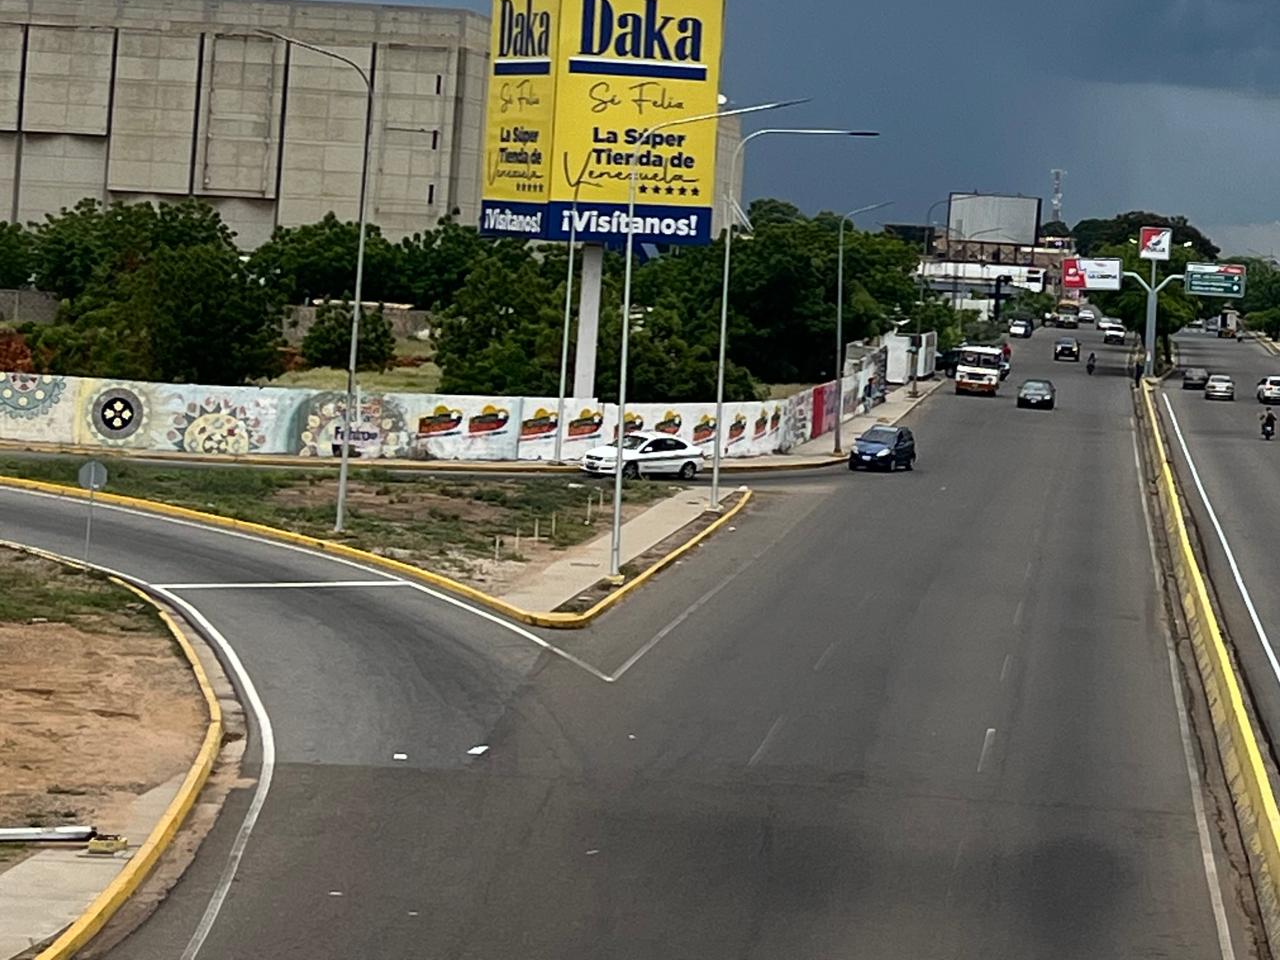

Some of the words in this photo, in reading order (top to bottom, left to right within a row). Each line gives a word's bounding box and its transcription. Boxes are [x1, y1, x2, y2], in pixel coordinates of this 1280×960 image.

[628, 81, 685, 115] Feliz
[592, 127, 618, 143] La
[669, 151, 695, 169] de
[561, 210, 698, 236] ¡Visítanos!
